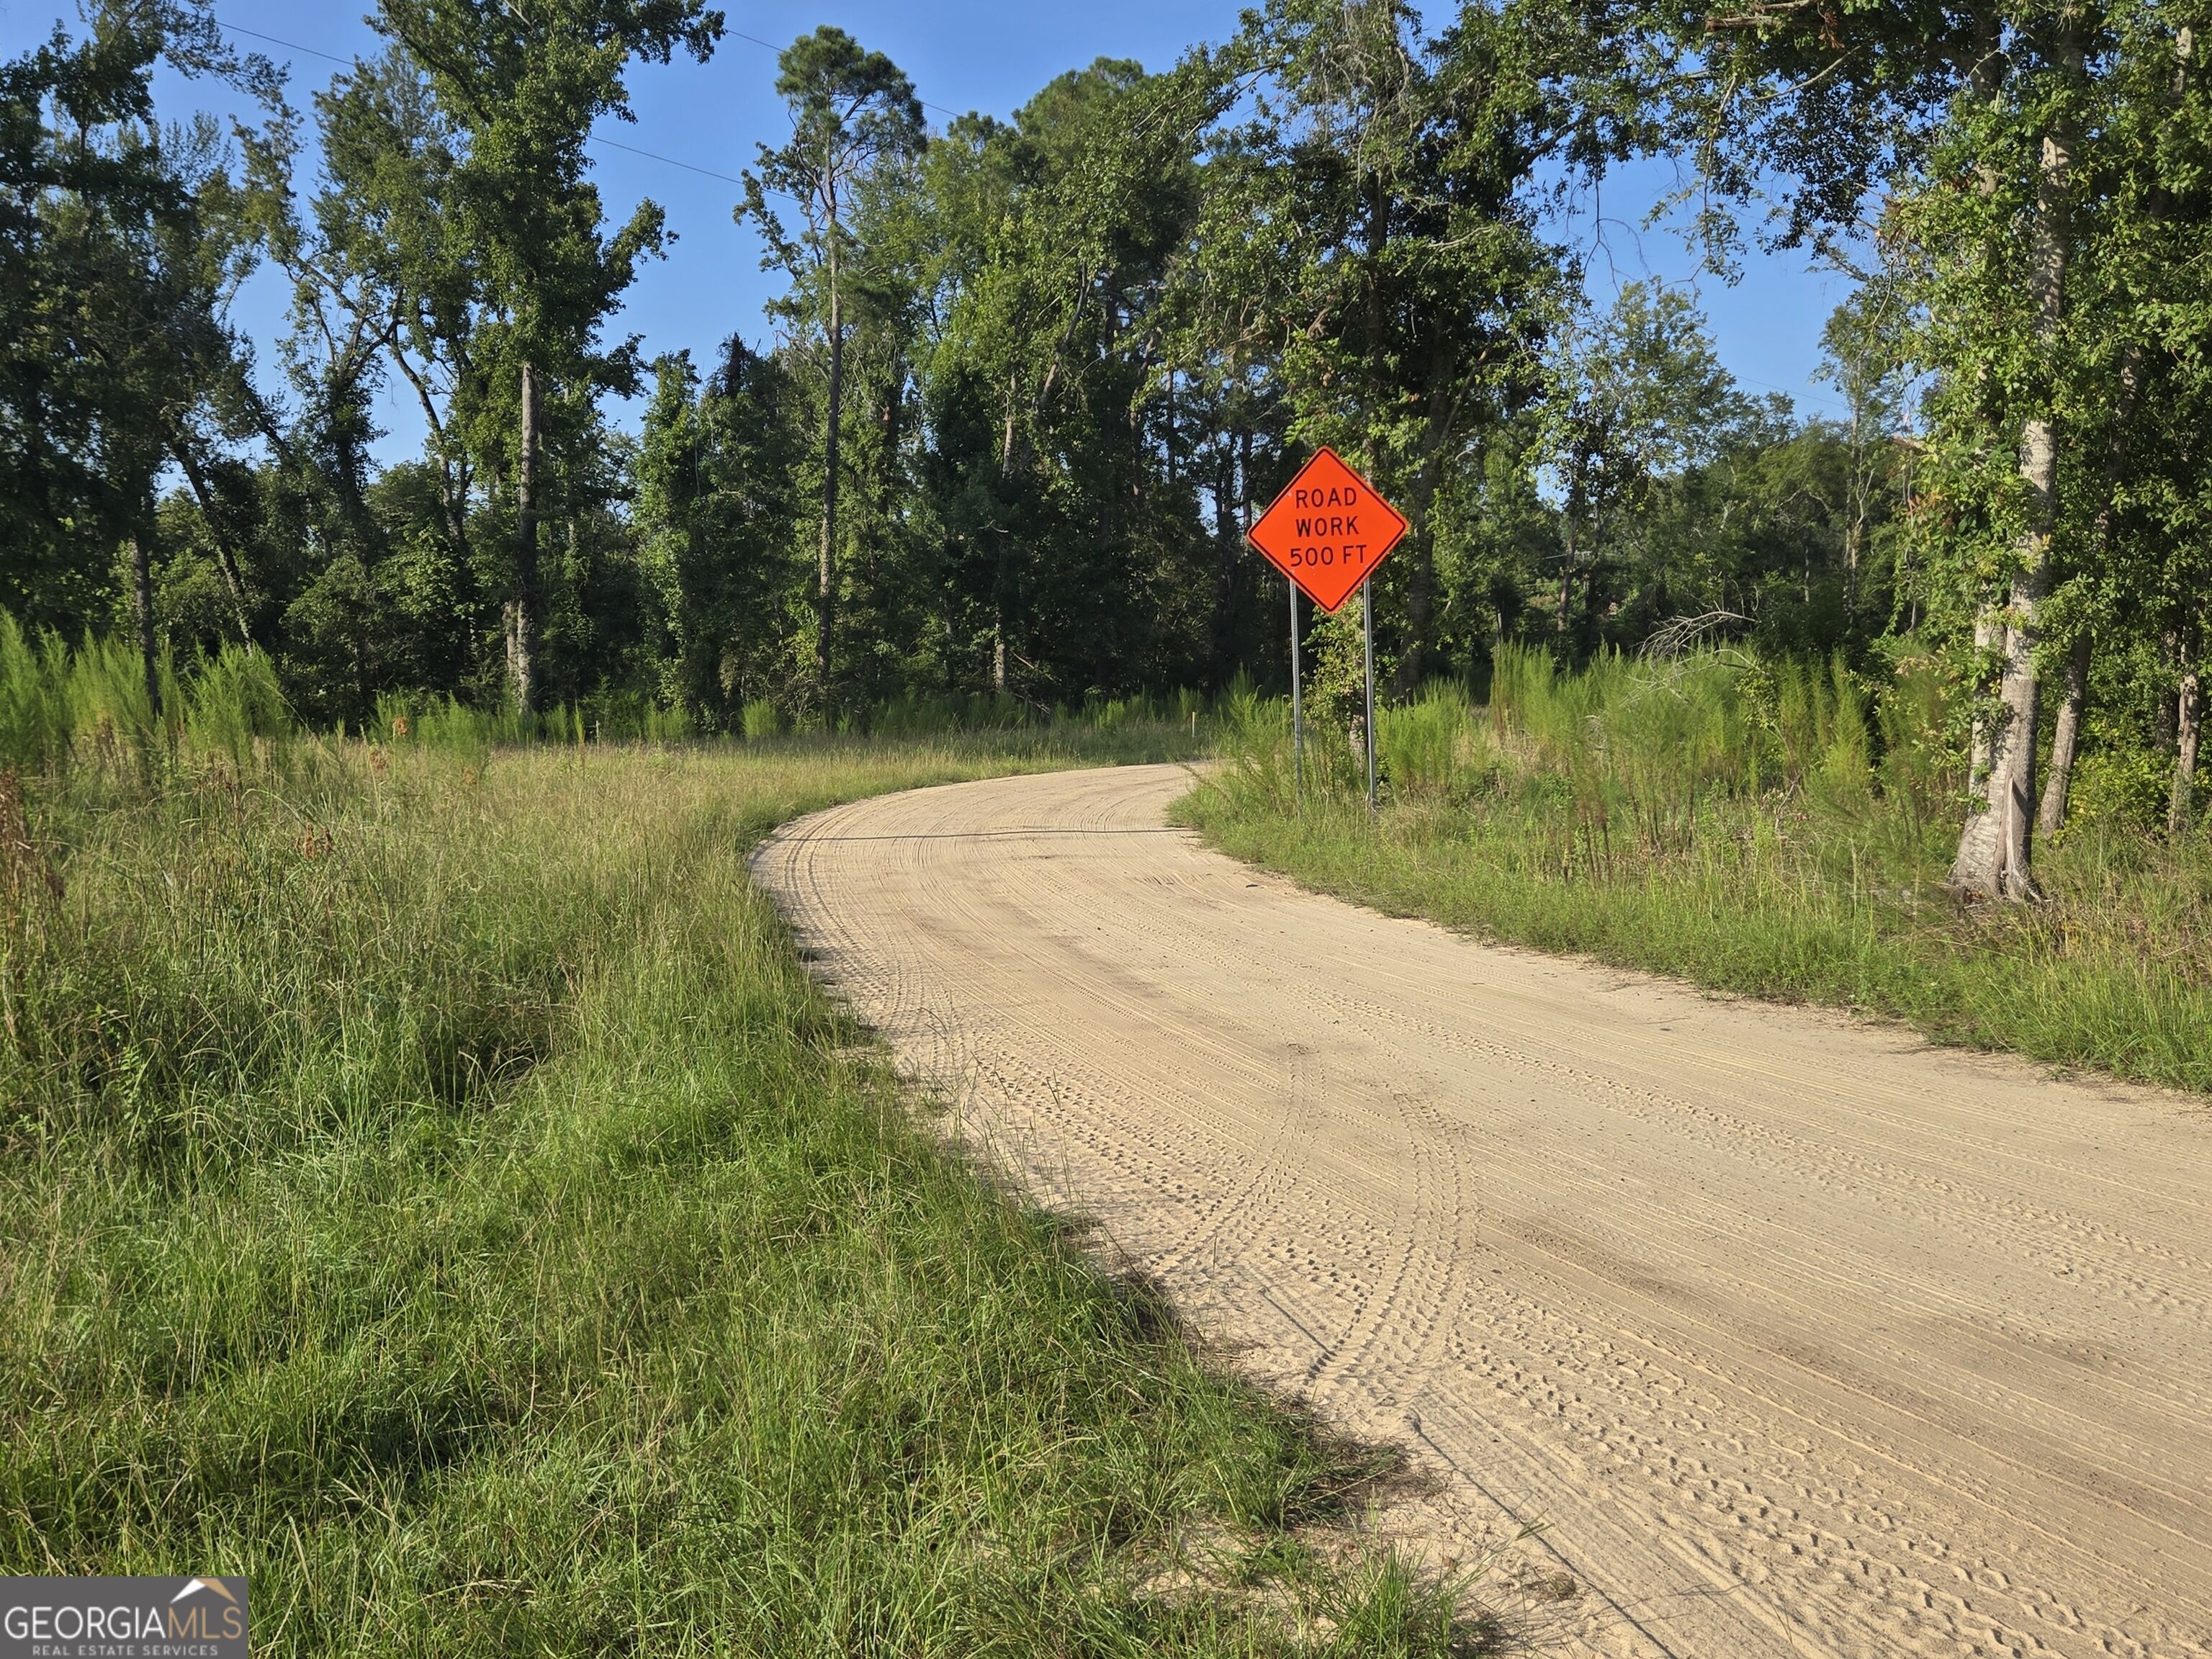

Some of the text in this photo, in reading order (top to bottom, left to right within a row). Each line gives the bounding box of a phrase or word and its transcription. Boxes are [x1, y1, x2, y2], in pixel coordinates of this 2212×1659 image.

[1295, 487, 1357, 509] ROAD
[1295, 516, 1359, 537] WORK
[1290, 544, 1367, 567] 500 FT
